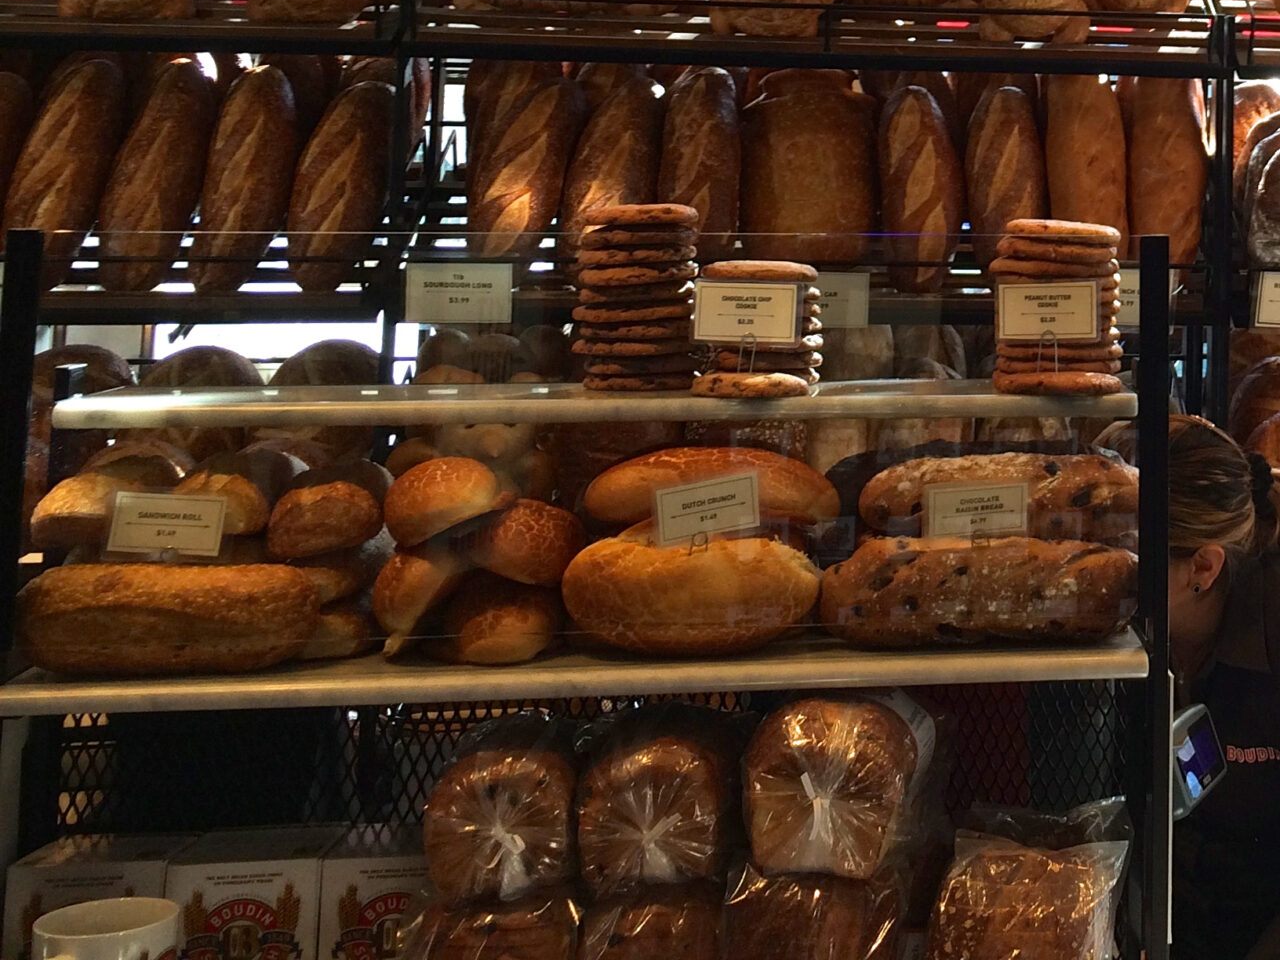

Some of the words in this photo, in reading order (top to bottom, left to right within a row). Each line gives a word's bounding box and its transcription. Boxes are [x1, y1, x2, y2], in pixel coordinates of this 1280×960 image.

[682, 500, 706, 510] DUTCH
[708, 494, 736, 505] CRUNCH
[960, 496, 1000, 505] CHOCOLATE
[955, 505, 979, 513] RAISIN
[138, 512, 180, 520] SANDWICH
[364, 897, 409, 920] BOUD
[210, 904, 275, 928] BOUDIN
